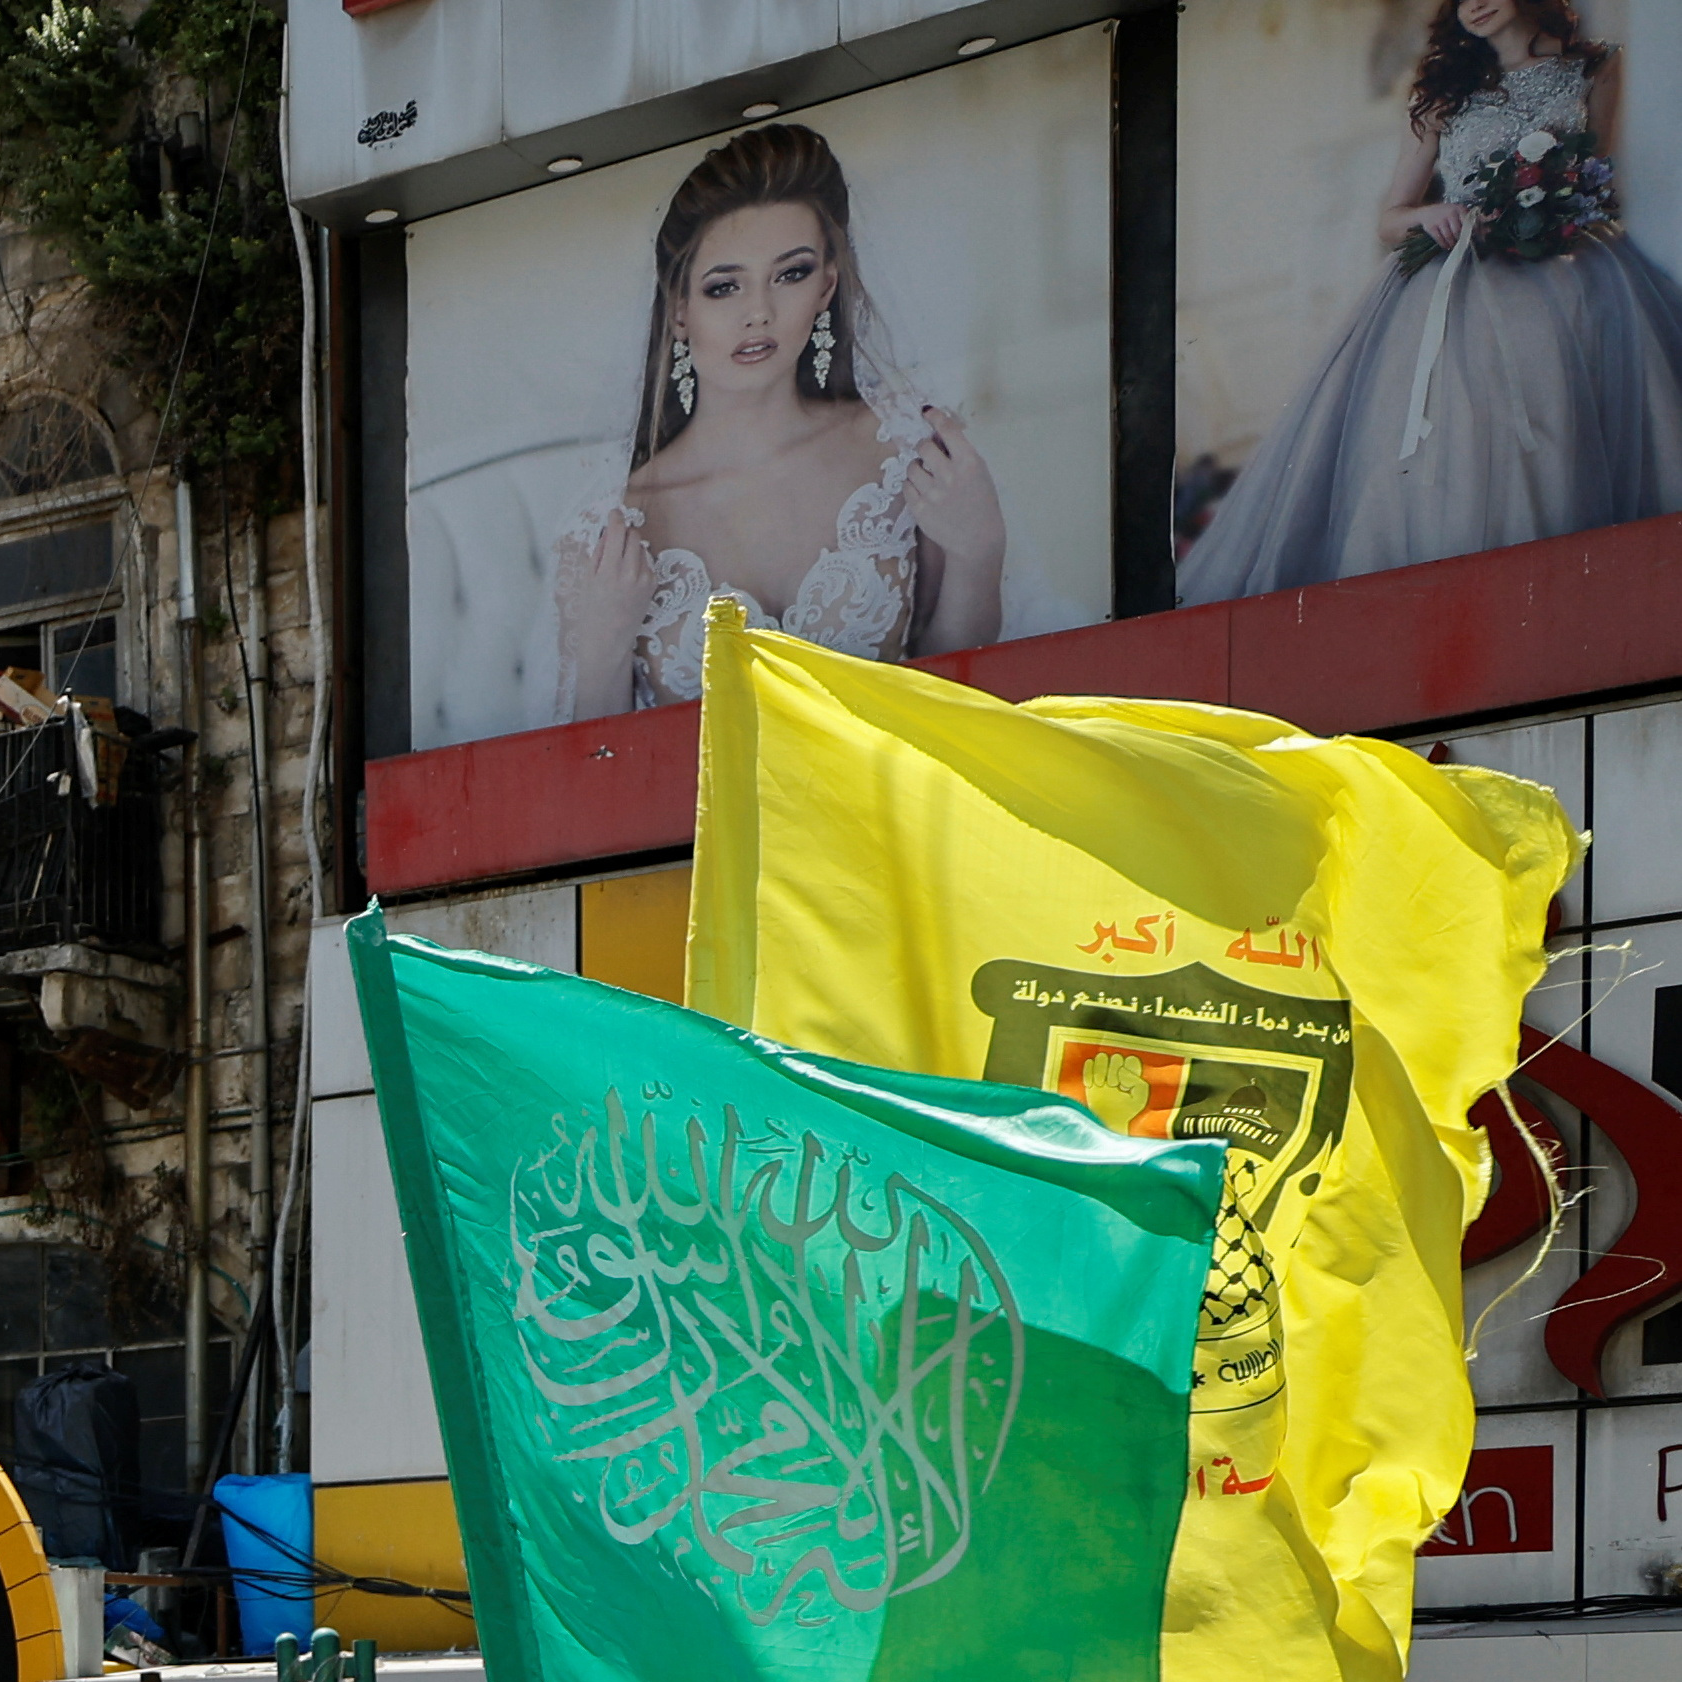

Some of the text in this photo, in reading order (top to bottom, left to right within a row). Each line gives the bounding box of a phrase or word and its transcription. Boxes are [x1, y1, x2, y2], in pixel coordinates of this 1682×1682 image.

[1074, 910, 1177, 965] أكبر
[1012, 979, 1066, 1009] دولة
[1070, 989, 1139, 1013] نصنع
[1142, 995, 1237, 1026] الشهداء
[1242, 1005, 1290, 1031] دماء
